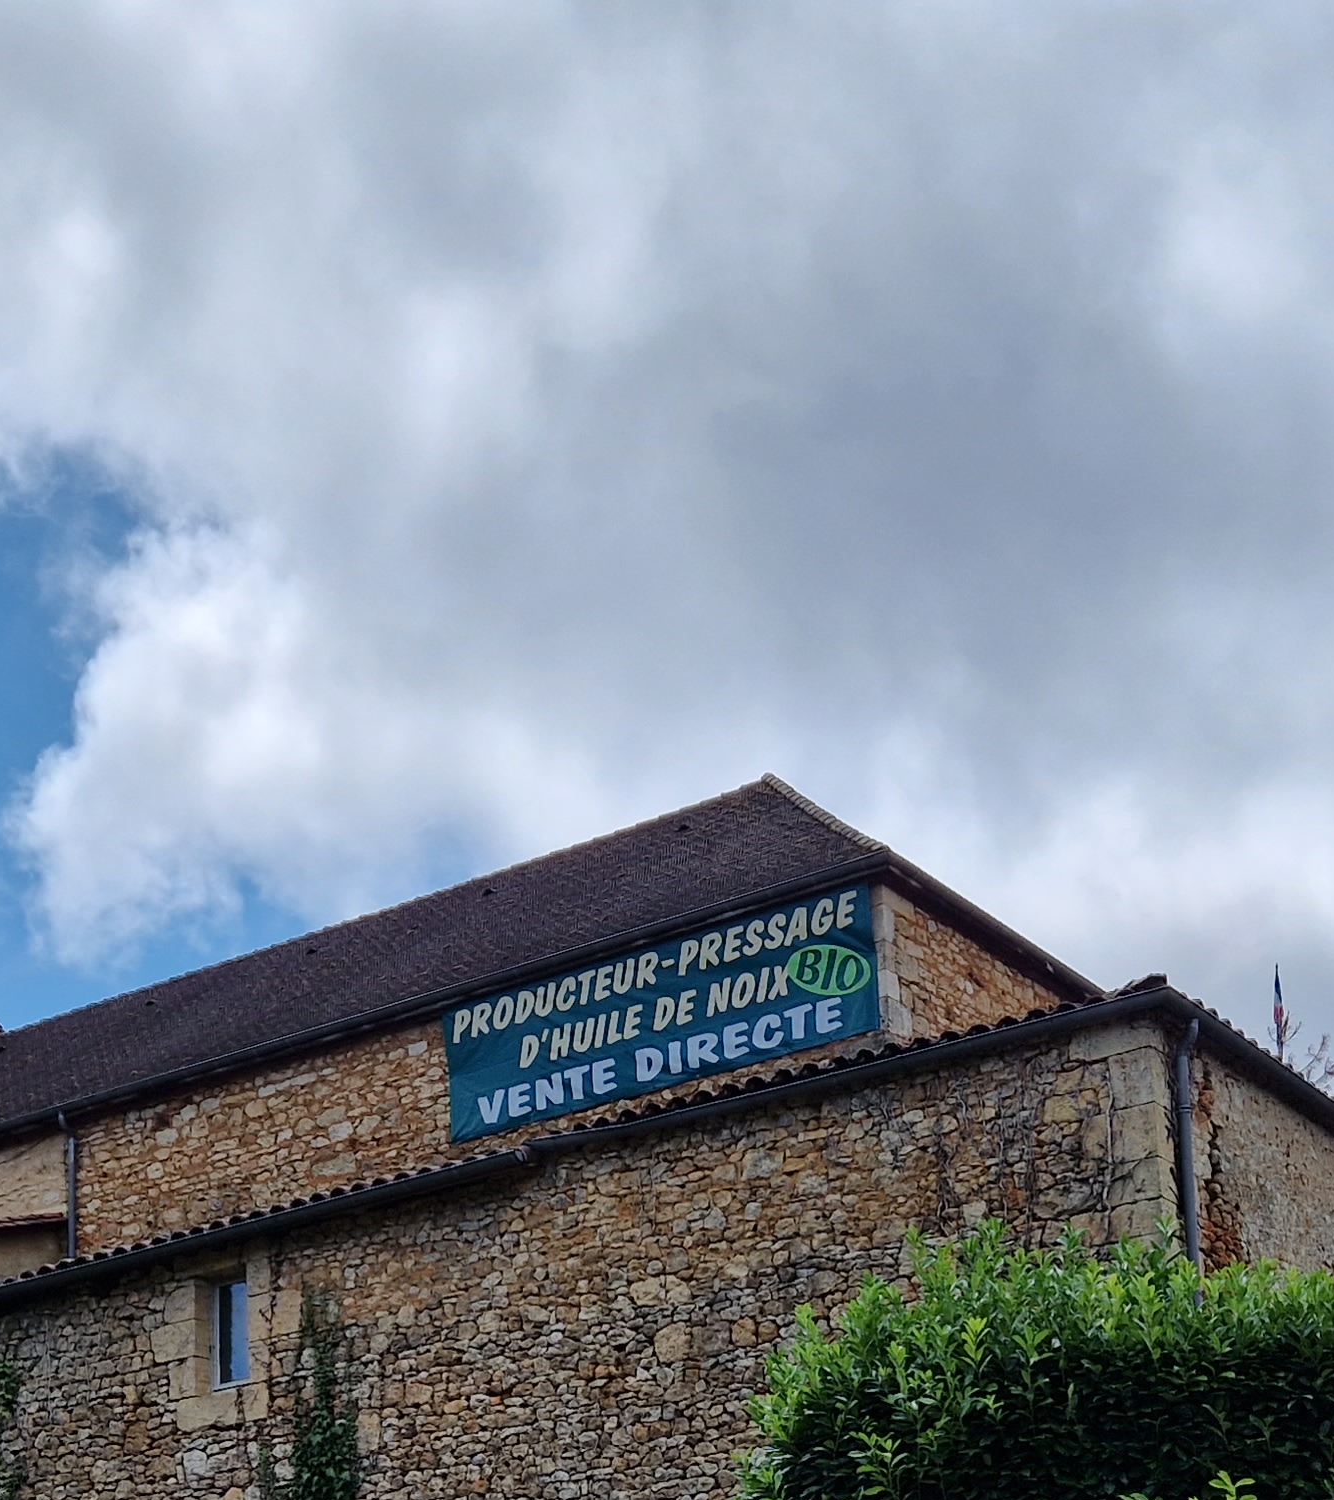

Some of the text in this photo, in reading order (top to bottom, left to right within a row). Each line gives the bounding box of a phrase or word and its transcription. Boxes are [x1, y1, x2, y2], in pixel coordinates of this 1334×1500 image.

[452, 890, 857, 1044] PRODUCTEUR-PRESSAGE
[519, 965, 789, 1068] D'HUILE DE NOIX
[796, 949, 865, 991] BIO
[477, 997, 843, 1124] VENTE DIRECTE
